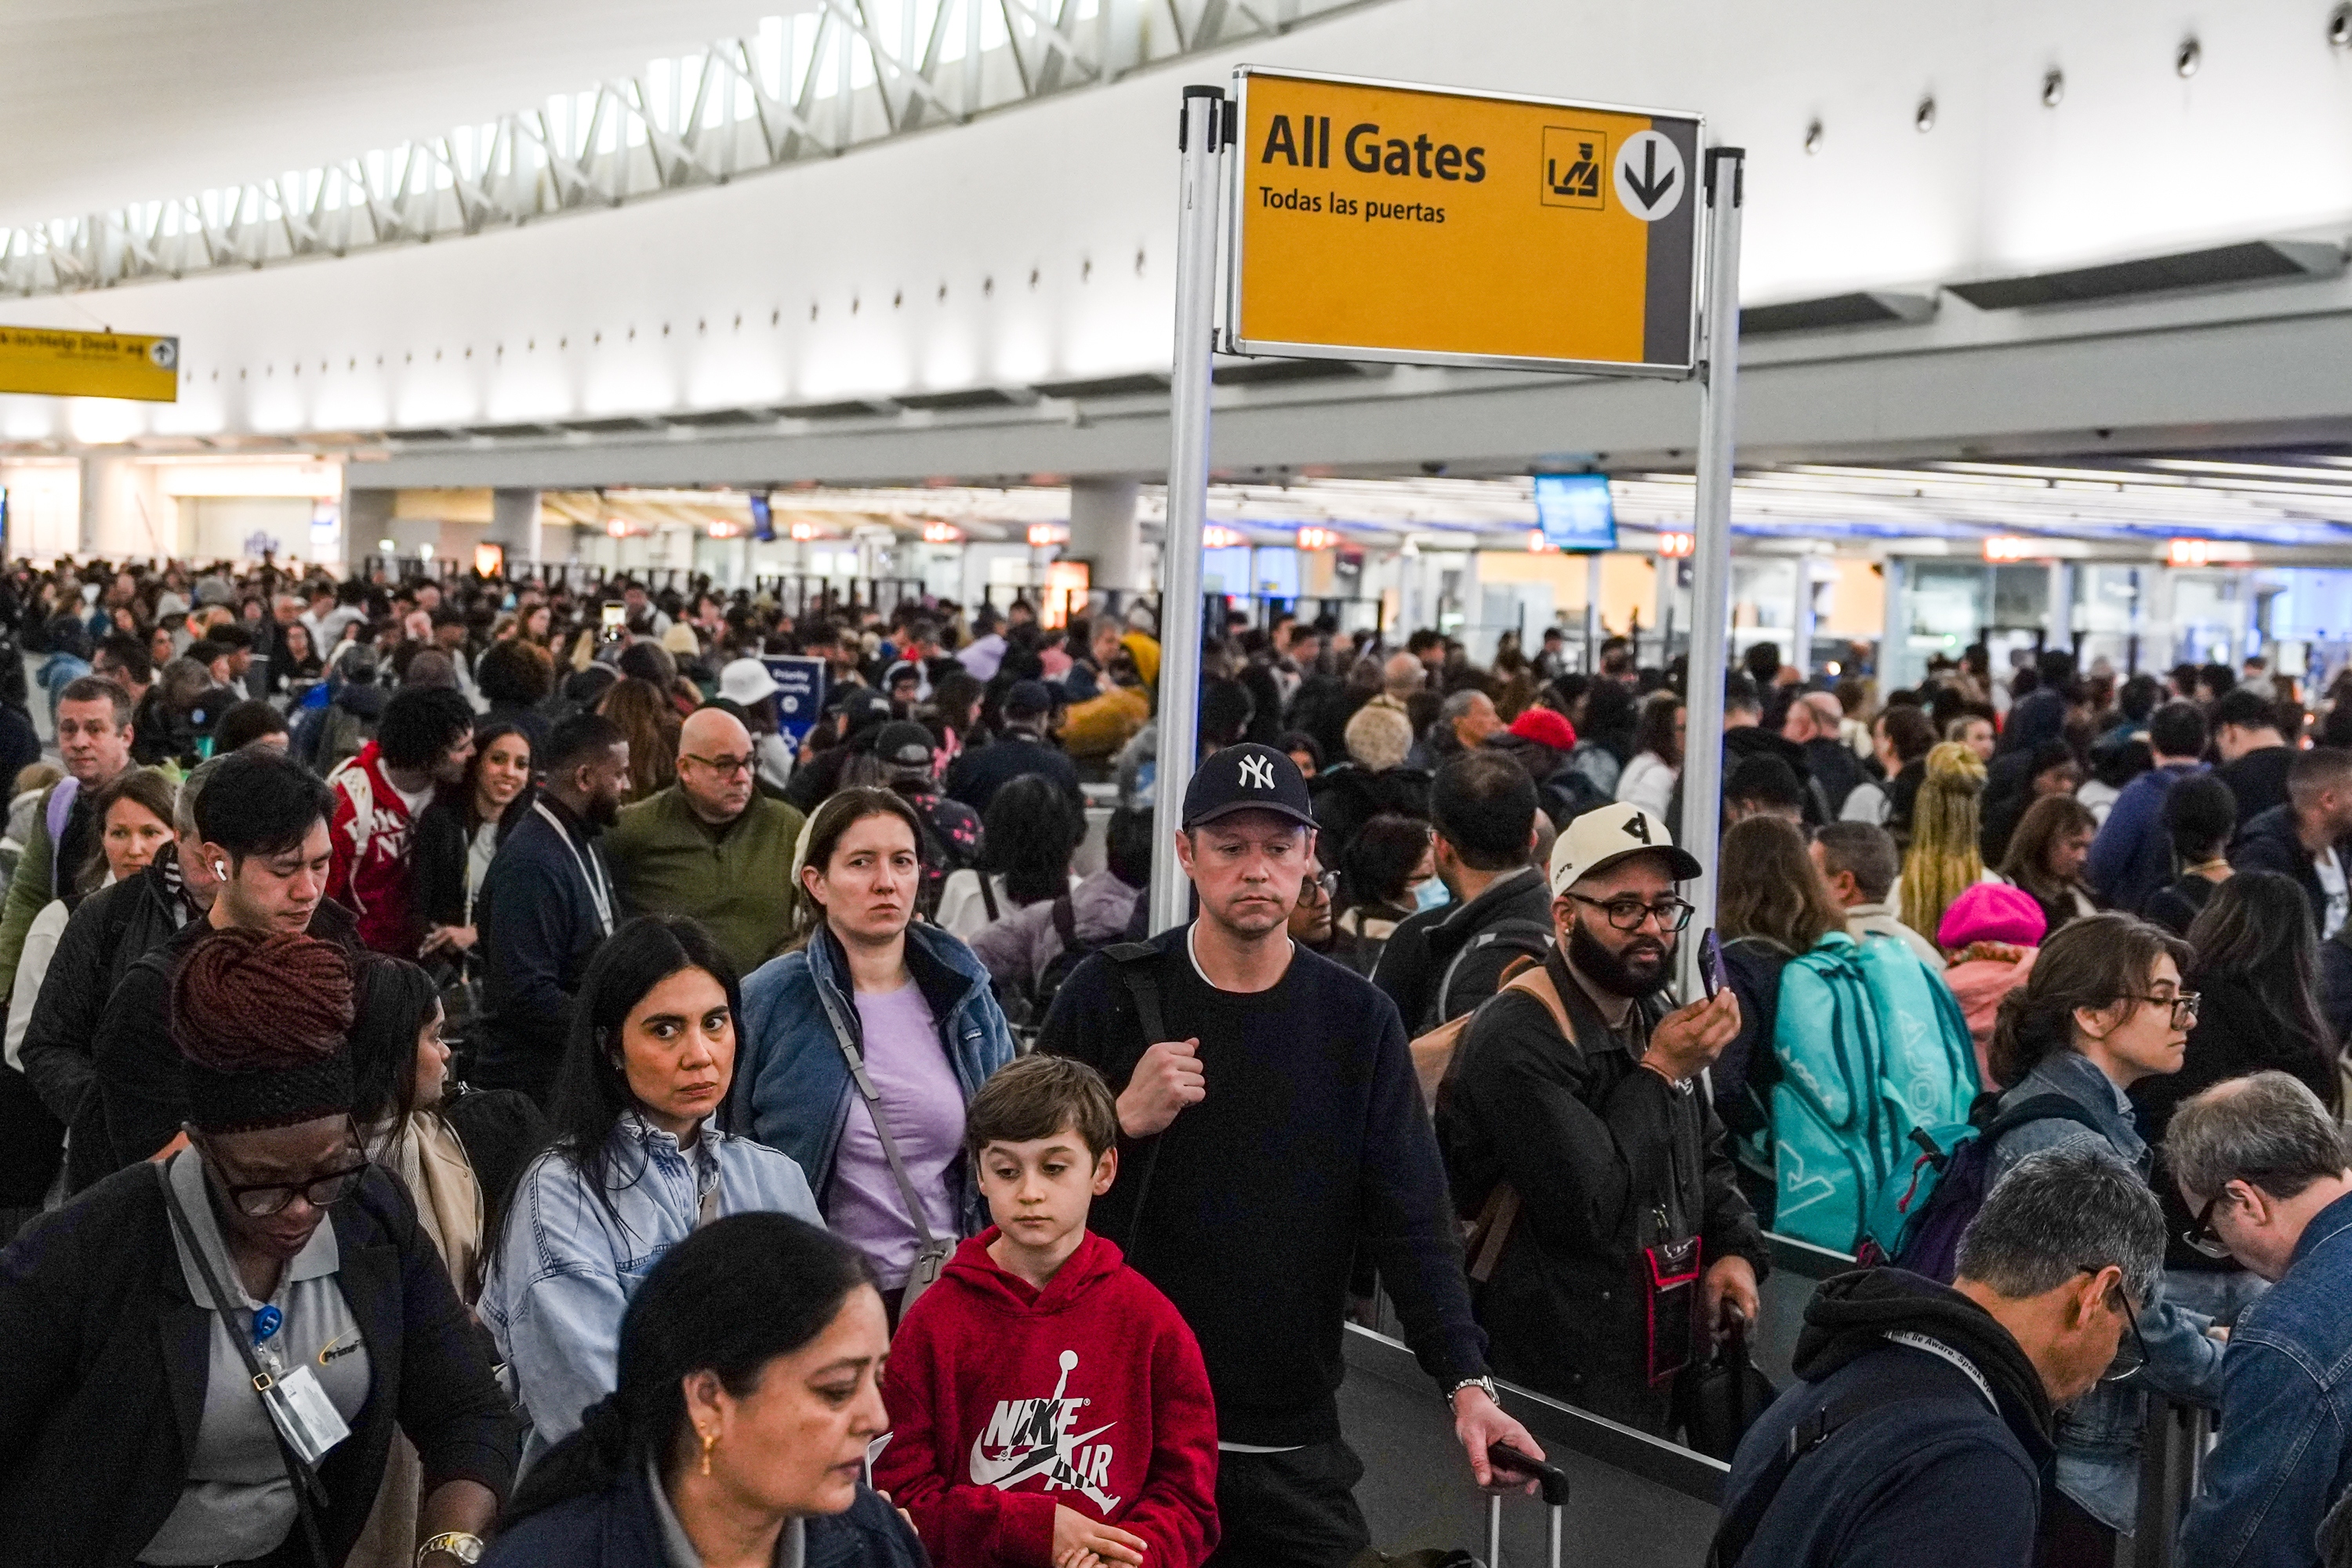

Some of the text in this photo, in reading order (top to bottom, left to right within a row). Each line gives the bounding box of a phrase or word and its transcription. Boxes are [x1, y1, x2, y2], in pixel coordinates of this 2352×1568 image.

[1261, 114, 1486, 183] All Gates
[1259, 187, 1446, 223] Todas las puertas
[1239, 754, 1276, 789] NY
[1911, 1333, 1923, 1343] Be
[1925, 1338, 1955, 1359] Aware.
[1957, 1354, 1982, 1381] Speak
[983, 1397, 1084, 1446] NIKE
[1044, 1444, 1113, 1491] AIR
